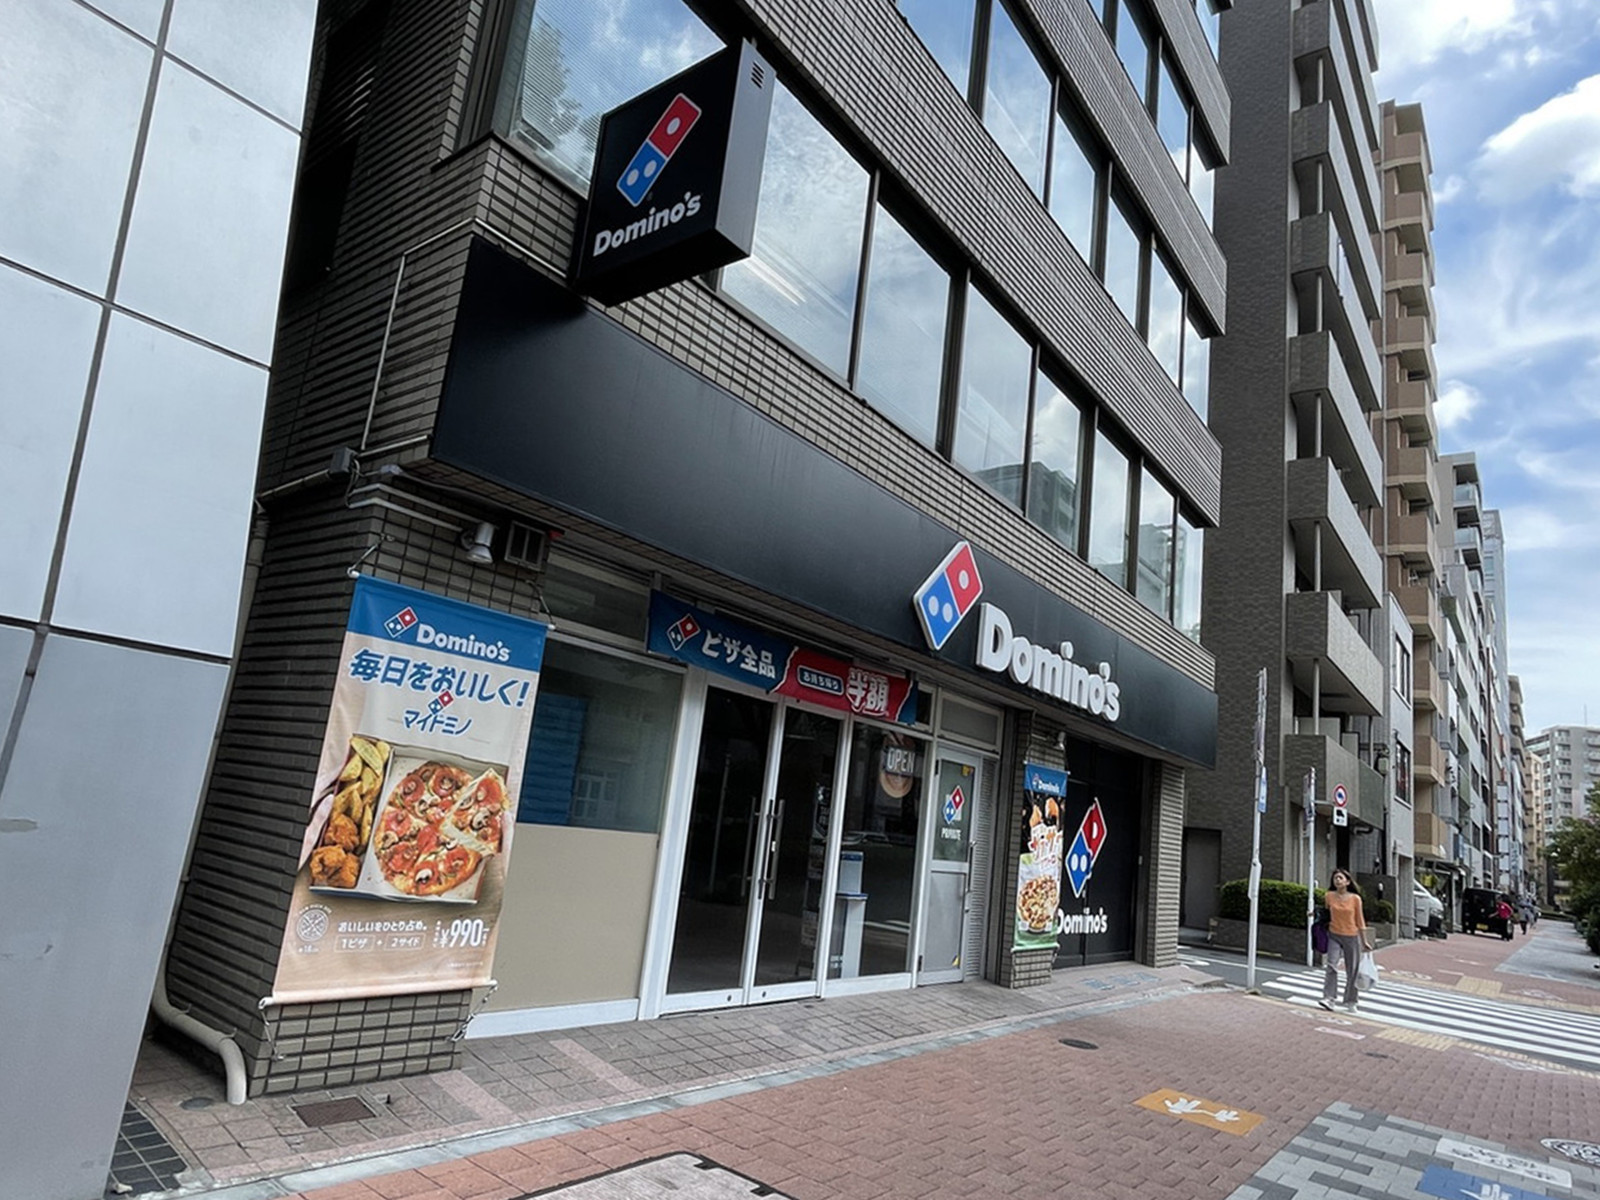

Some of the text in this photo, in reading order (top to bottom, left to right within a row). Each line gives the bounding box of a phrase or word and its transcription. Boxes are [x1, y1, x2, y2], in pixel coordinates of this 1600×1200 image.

[593, 191, 701, 257] Domino's
[416, 623, 511, 662] Domino's
[701, 629, 776, 679] ピザ全品
[976, 602, 1120, 722] Domino's
[847, 669, 890, 713] 半額
[886, 747, 916, 773] OPEN
